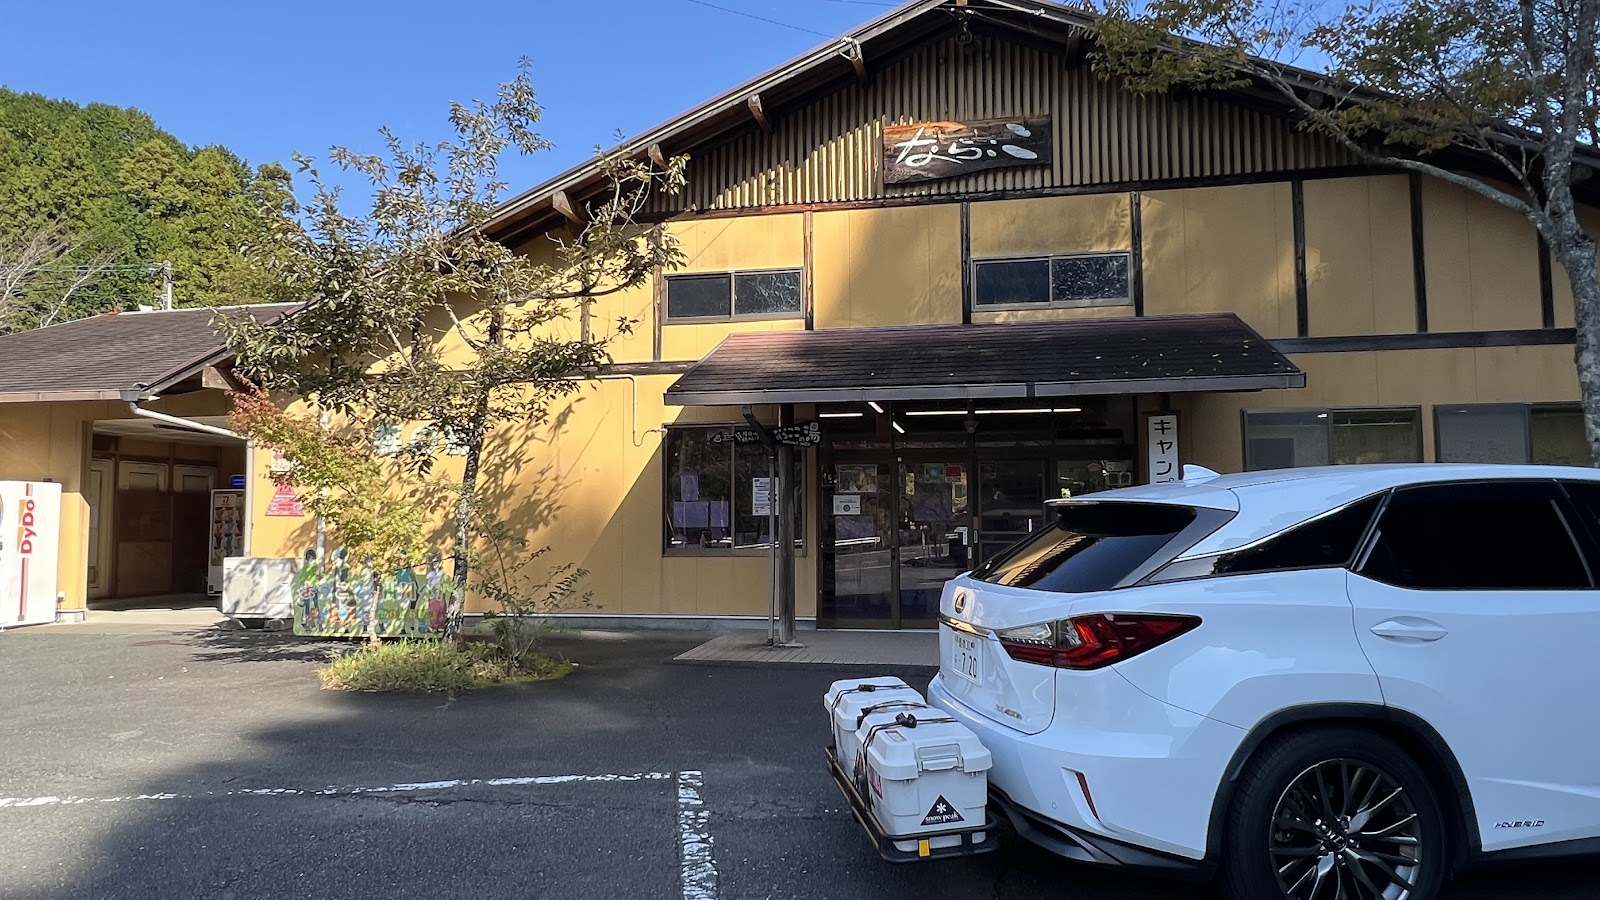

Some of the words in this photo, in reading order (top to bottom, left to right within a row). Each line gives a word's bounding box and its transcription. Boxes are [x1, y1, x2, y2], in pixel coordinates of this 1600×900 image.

[20, 499, 37, 554] DyDo
[925, 814, 942, 822] snow
[942, 811, 959, 822] peak
[1493, 820, 1545, 829] HYBRID
